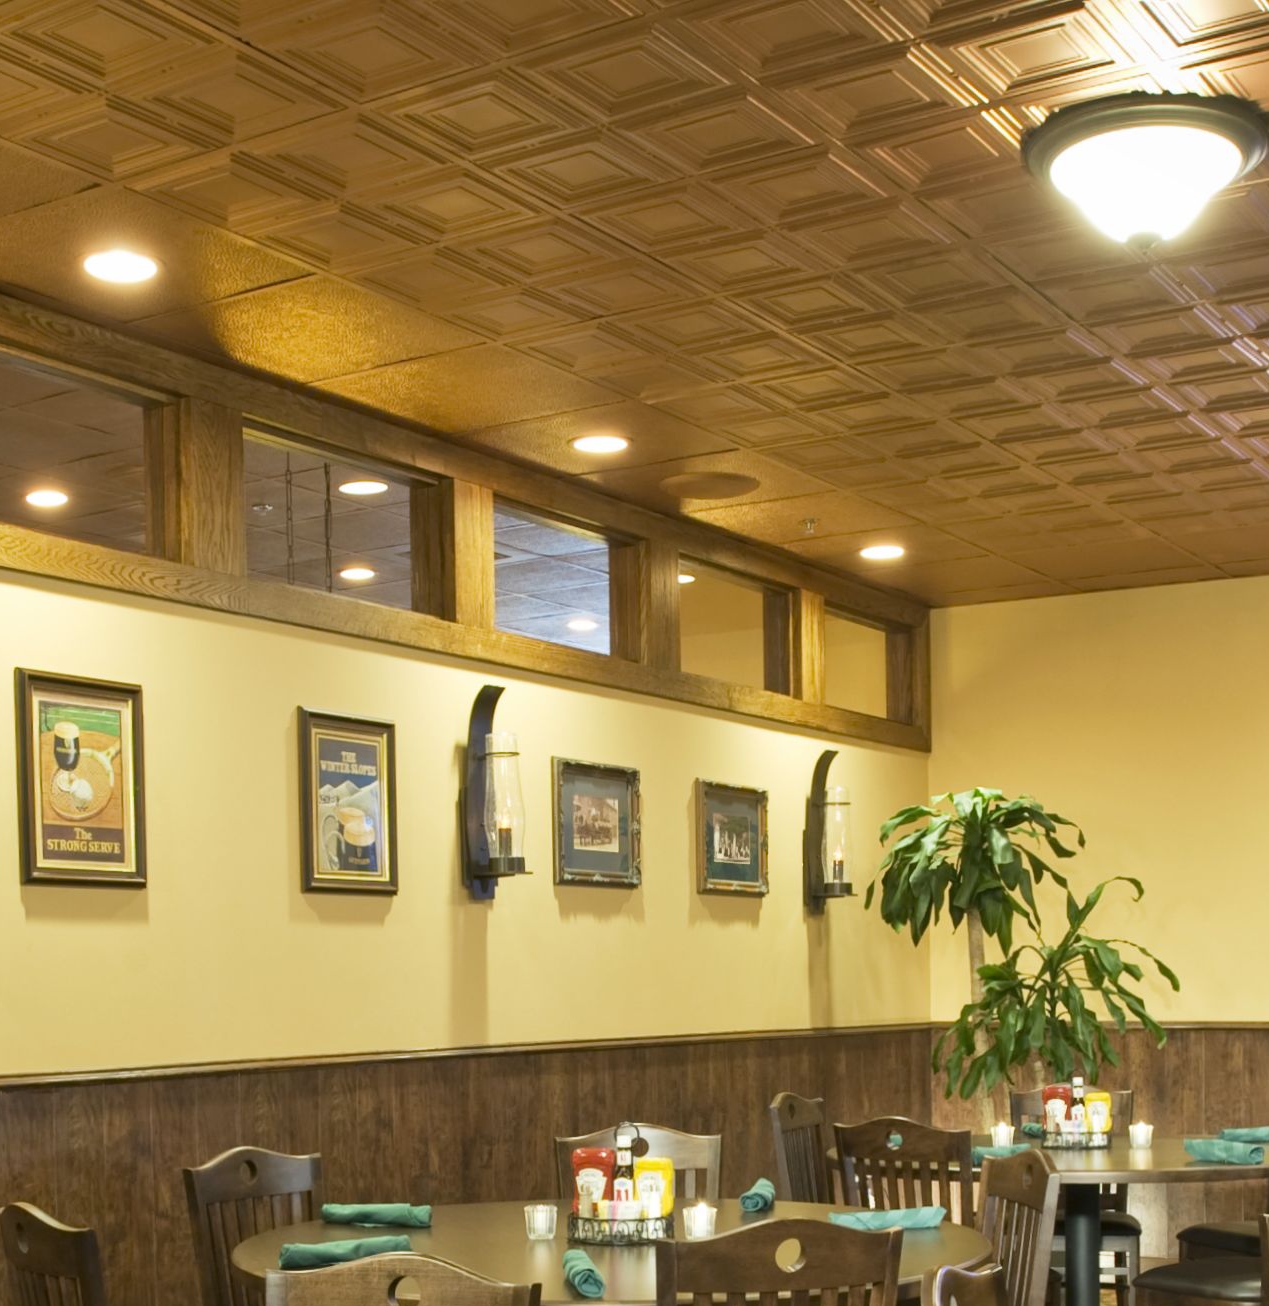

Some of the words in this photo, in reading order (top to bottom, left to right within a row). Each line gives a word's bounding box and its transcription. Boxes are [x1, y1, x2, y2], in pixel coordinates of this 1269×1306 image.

[341, 751, 356, 763] THE
[320, 760, 350, 774] WINTER
[351, 764, 377, 777] SLOPES
[74, 828, 92, 840] The
[47, 839, 87, 852] STRONG
[89, 842, 120, 854] SERVE
